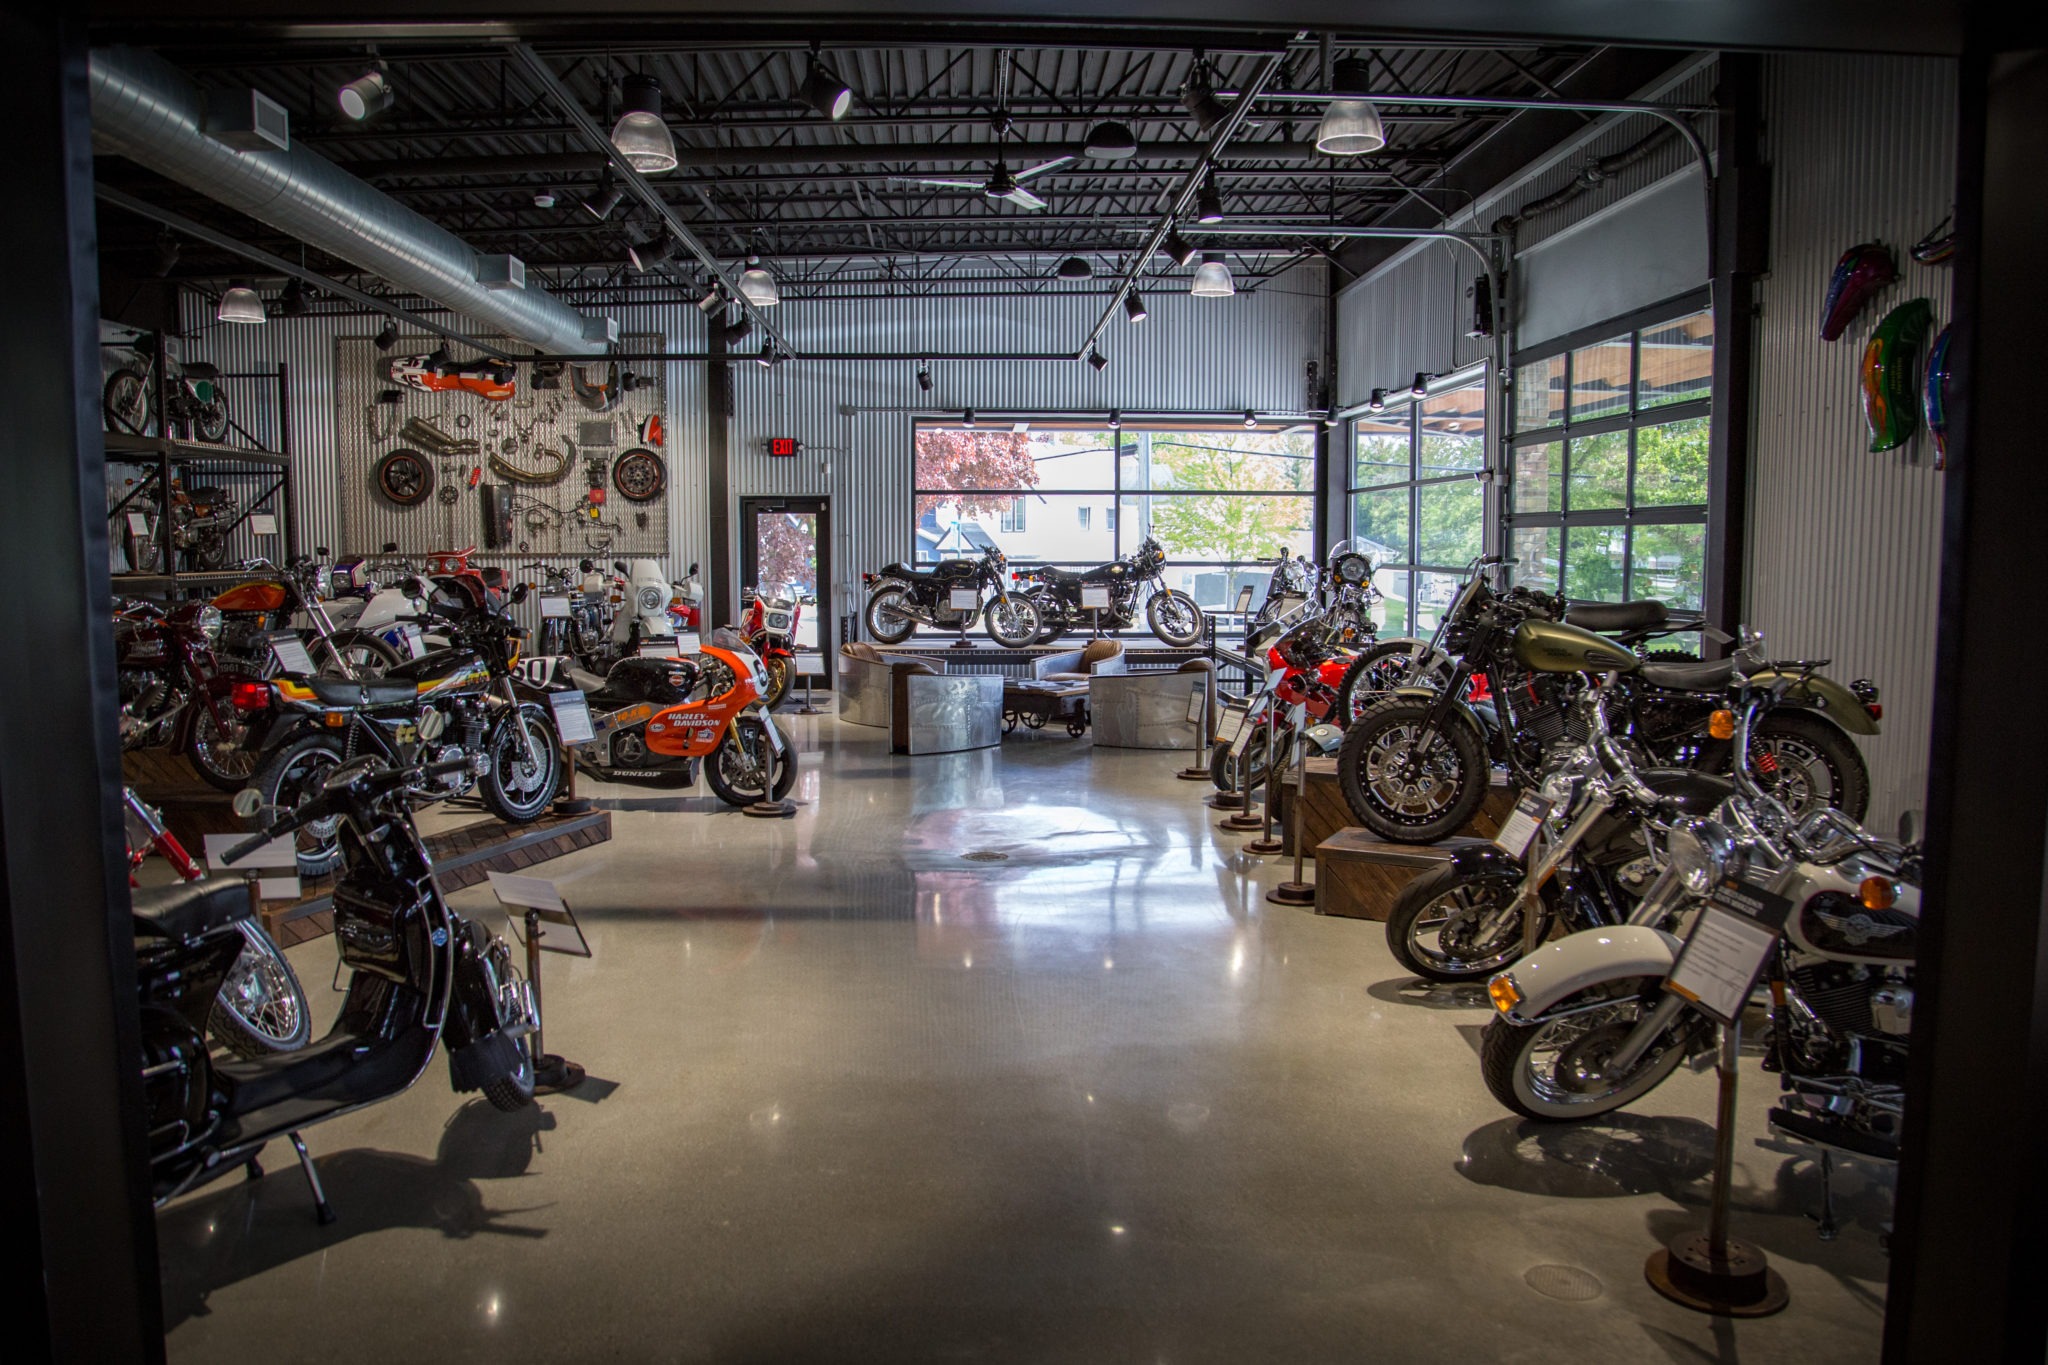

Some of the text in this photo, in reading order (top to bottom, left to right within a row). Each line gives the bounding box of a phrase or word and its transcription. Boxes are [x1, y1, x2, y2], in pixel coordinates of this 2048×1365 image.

[773, 439, 793, 455] EXIT
[220, 663, 239, 673] 1961
[668, 713, 709, 721] HARLEY-
